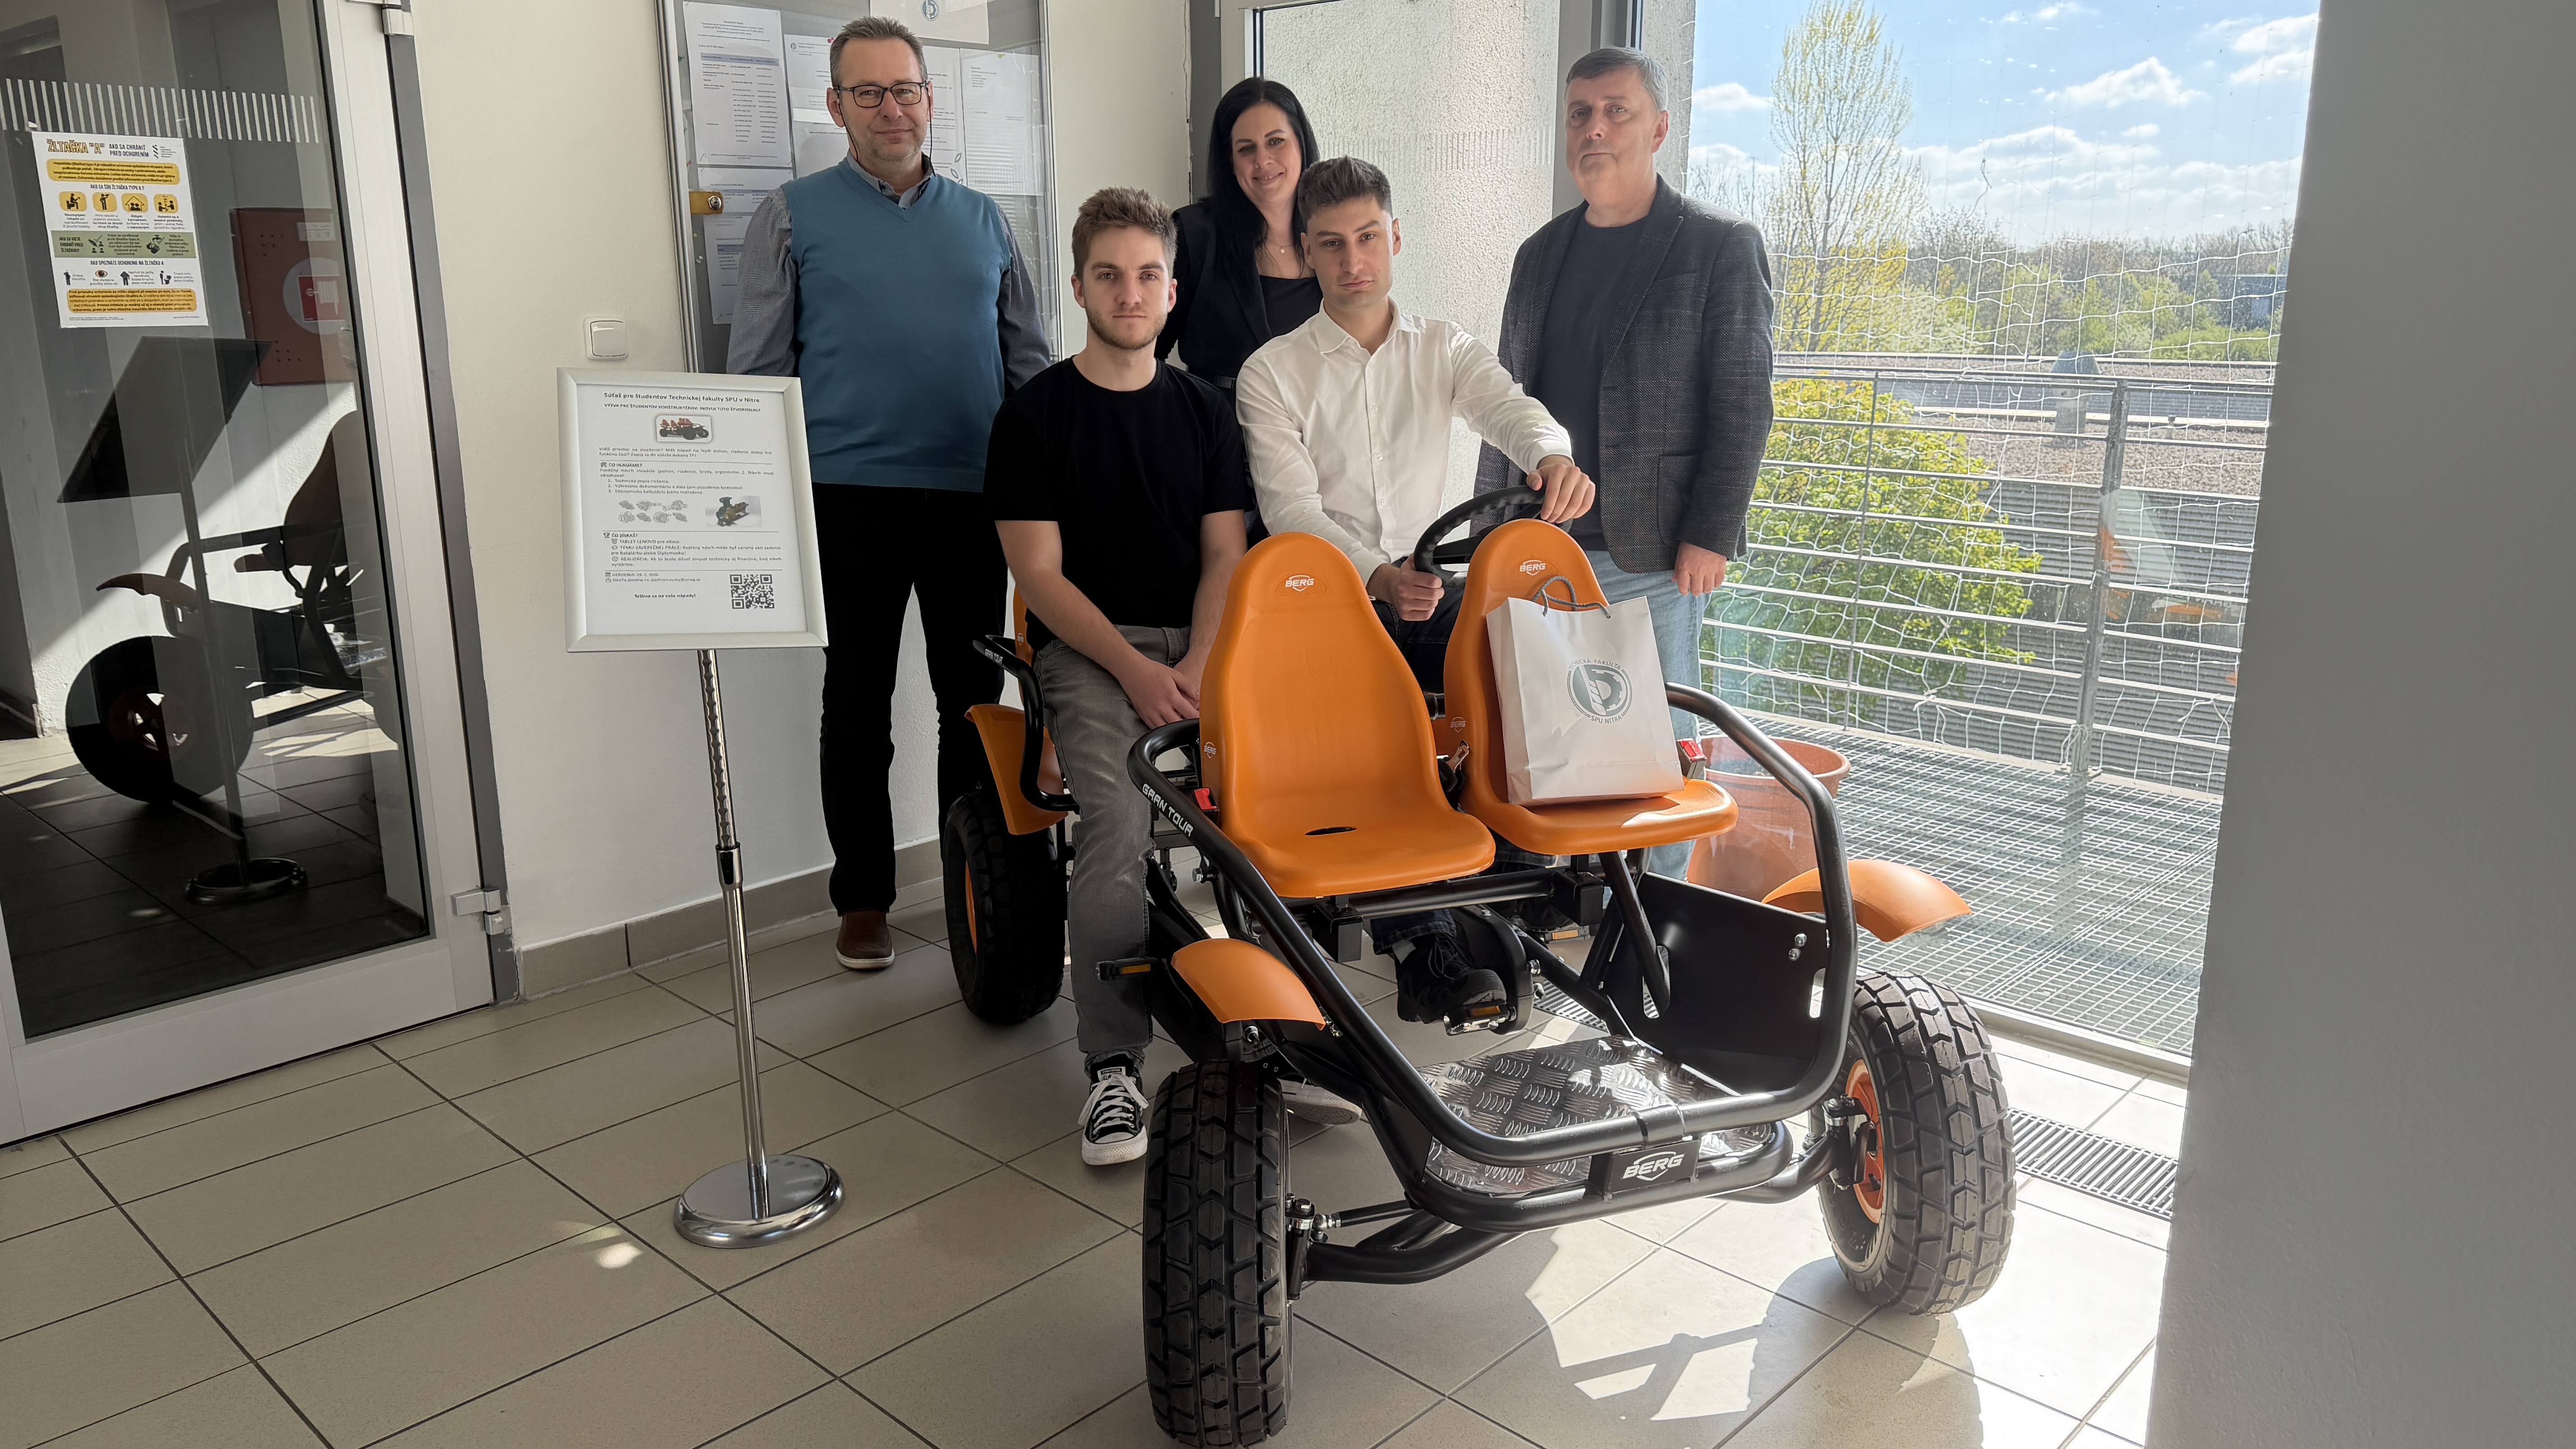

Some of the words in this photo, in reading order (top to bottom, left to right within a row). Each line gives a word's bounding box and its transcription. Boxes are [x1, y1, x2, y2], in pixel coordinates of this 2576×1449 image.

[46, 139, 88, 153] ŽLTAČKA
[1519, 563, 1546, 572] BERG
[1285, 578, 1315, 588] BERG
[1594, 659, 1621, 671] FAKULTA
[1591, 715, 1603, 724] SPU
[1605, 715, 1622, 724] NITRA
[1142, 783, 1168, 812] GRAN
[1168, 806, 1194, 837] TOUR
[1623, 1154, 1685, 1179] BERG
